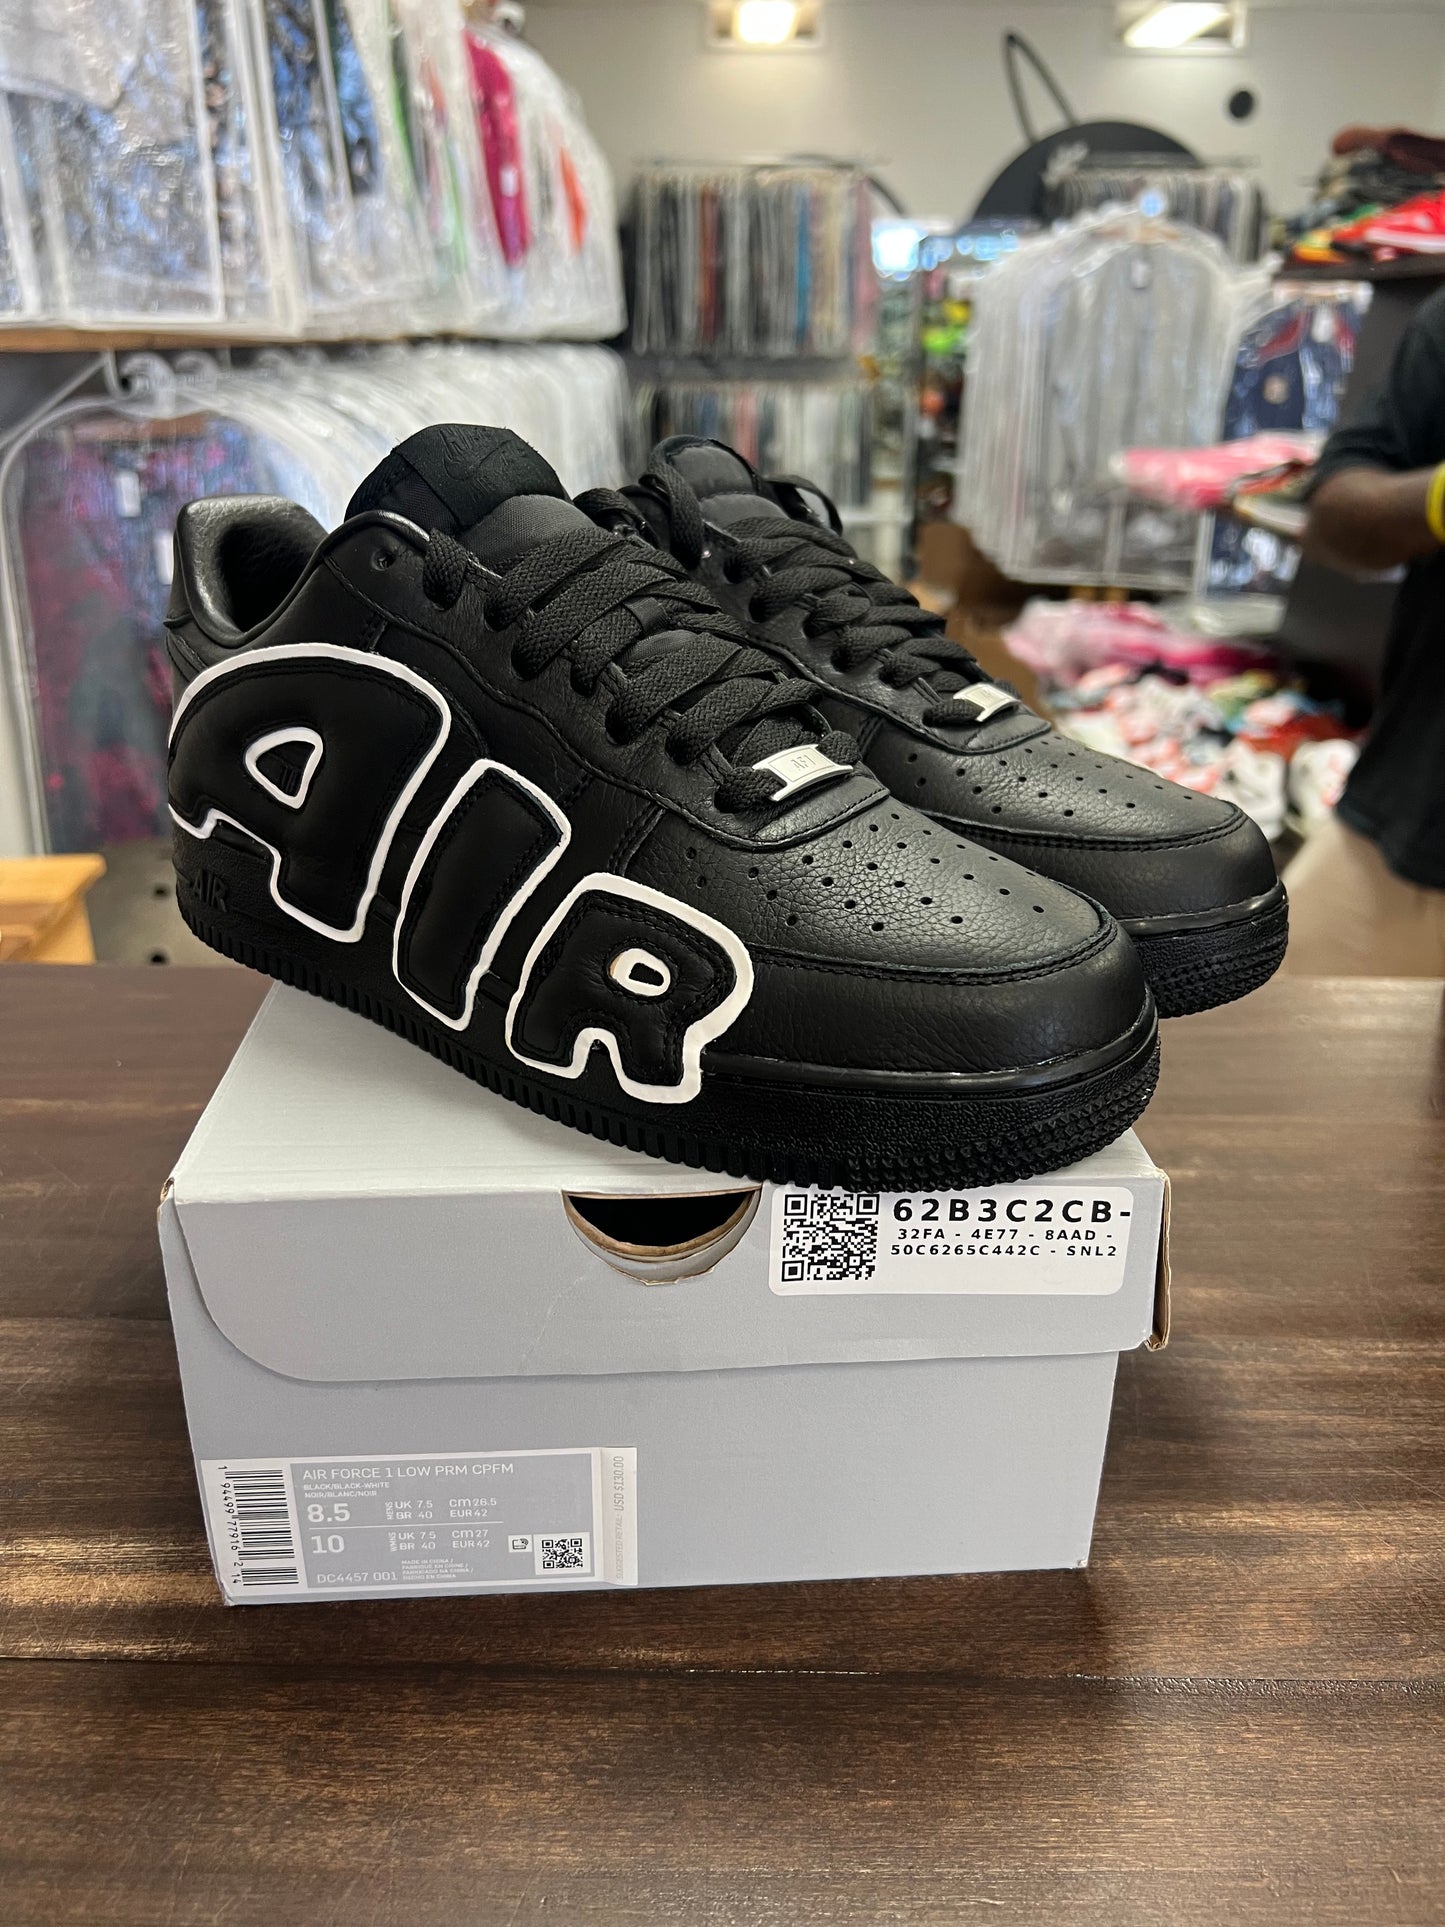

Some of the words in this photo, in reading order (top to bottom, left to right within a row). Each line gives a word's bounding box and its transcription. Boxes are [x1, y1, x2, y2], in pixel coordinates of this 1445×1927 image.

[168, 642, 754, 1104] AIR
[893, 1198, 1131, 1223] 62B3C2CB-
[898, 1228, 945, 1240] 32FA
[971, 1228, 1018, 1240] 4E77
[1045, 1229, 1096, 1240] 8AAD
[890, 1244, 1040, 1256] 50C6265C442C
[1066, 1245, 1117, 1257] SNL2
[303, 1469, 328, 1480] AIR
[331, 1467, 381, 1479] FORCE
[397, 1465, 431, 1478] LOW
[435, 1465, 468, 1476] PRM
[472, 1463, 514, 1475] CPFM
[303, 1481, 390, 1490] BLACK/BLACK-WHITE
[395, 1501, 412, 1509] UK
[416, 1500, 433, 1508] 7.5
[613, 1494, 624, 1511] USD
[307, 1503, 351, 1522] 8.5
[396, 1511, 412, 1519] BR
[418, 1510, 433, 1519] 40
[450, 1509, 472, 1518] EUR
[474, 1509, 488, 1517] 42
[398, 1532, 415, 1540] UK
[420, 1531, 436, 1540] 75
[452, 1529, 474, 1538] cm
[475, 1529, 489, 1537] 27
[311, 1534, 345, 1554] 10
[400, 1542, 415, 1550] BR
[421, 1541, 436, 1550] 40
[452, 1540, 475, 1549] EUR
[476, 1539, 490, 1548] 42
[317, 1572, 369, 1583] DC4457
[373, 1571, 397, 1580] 001
